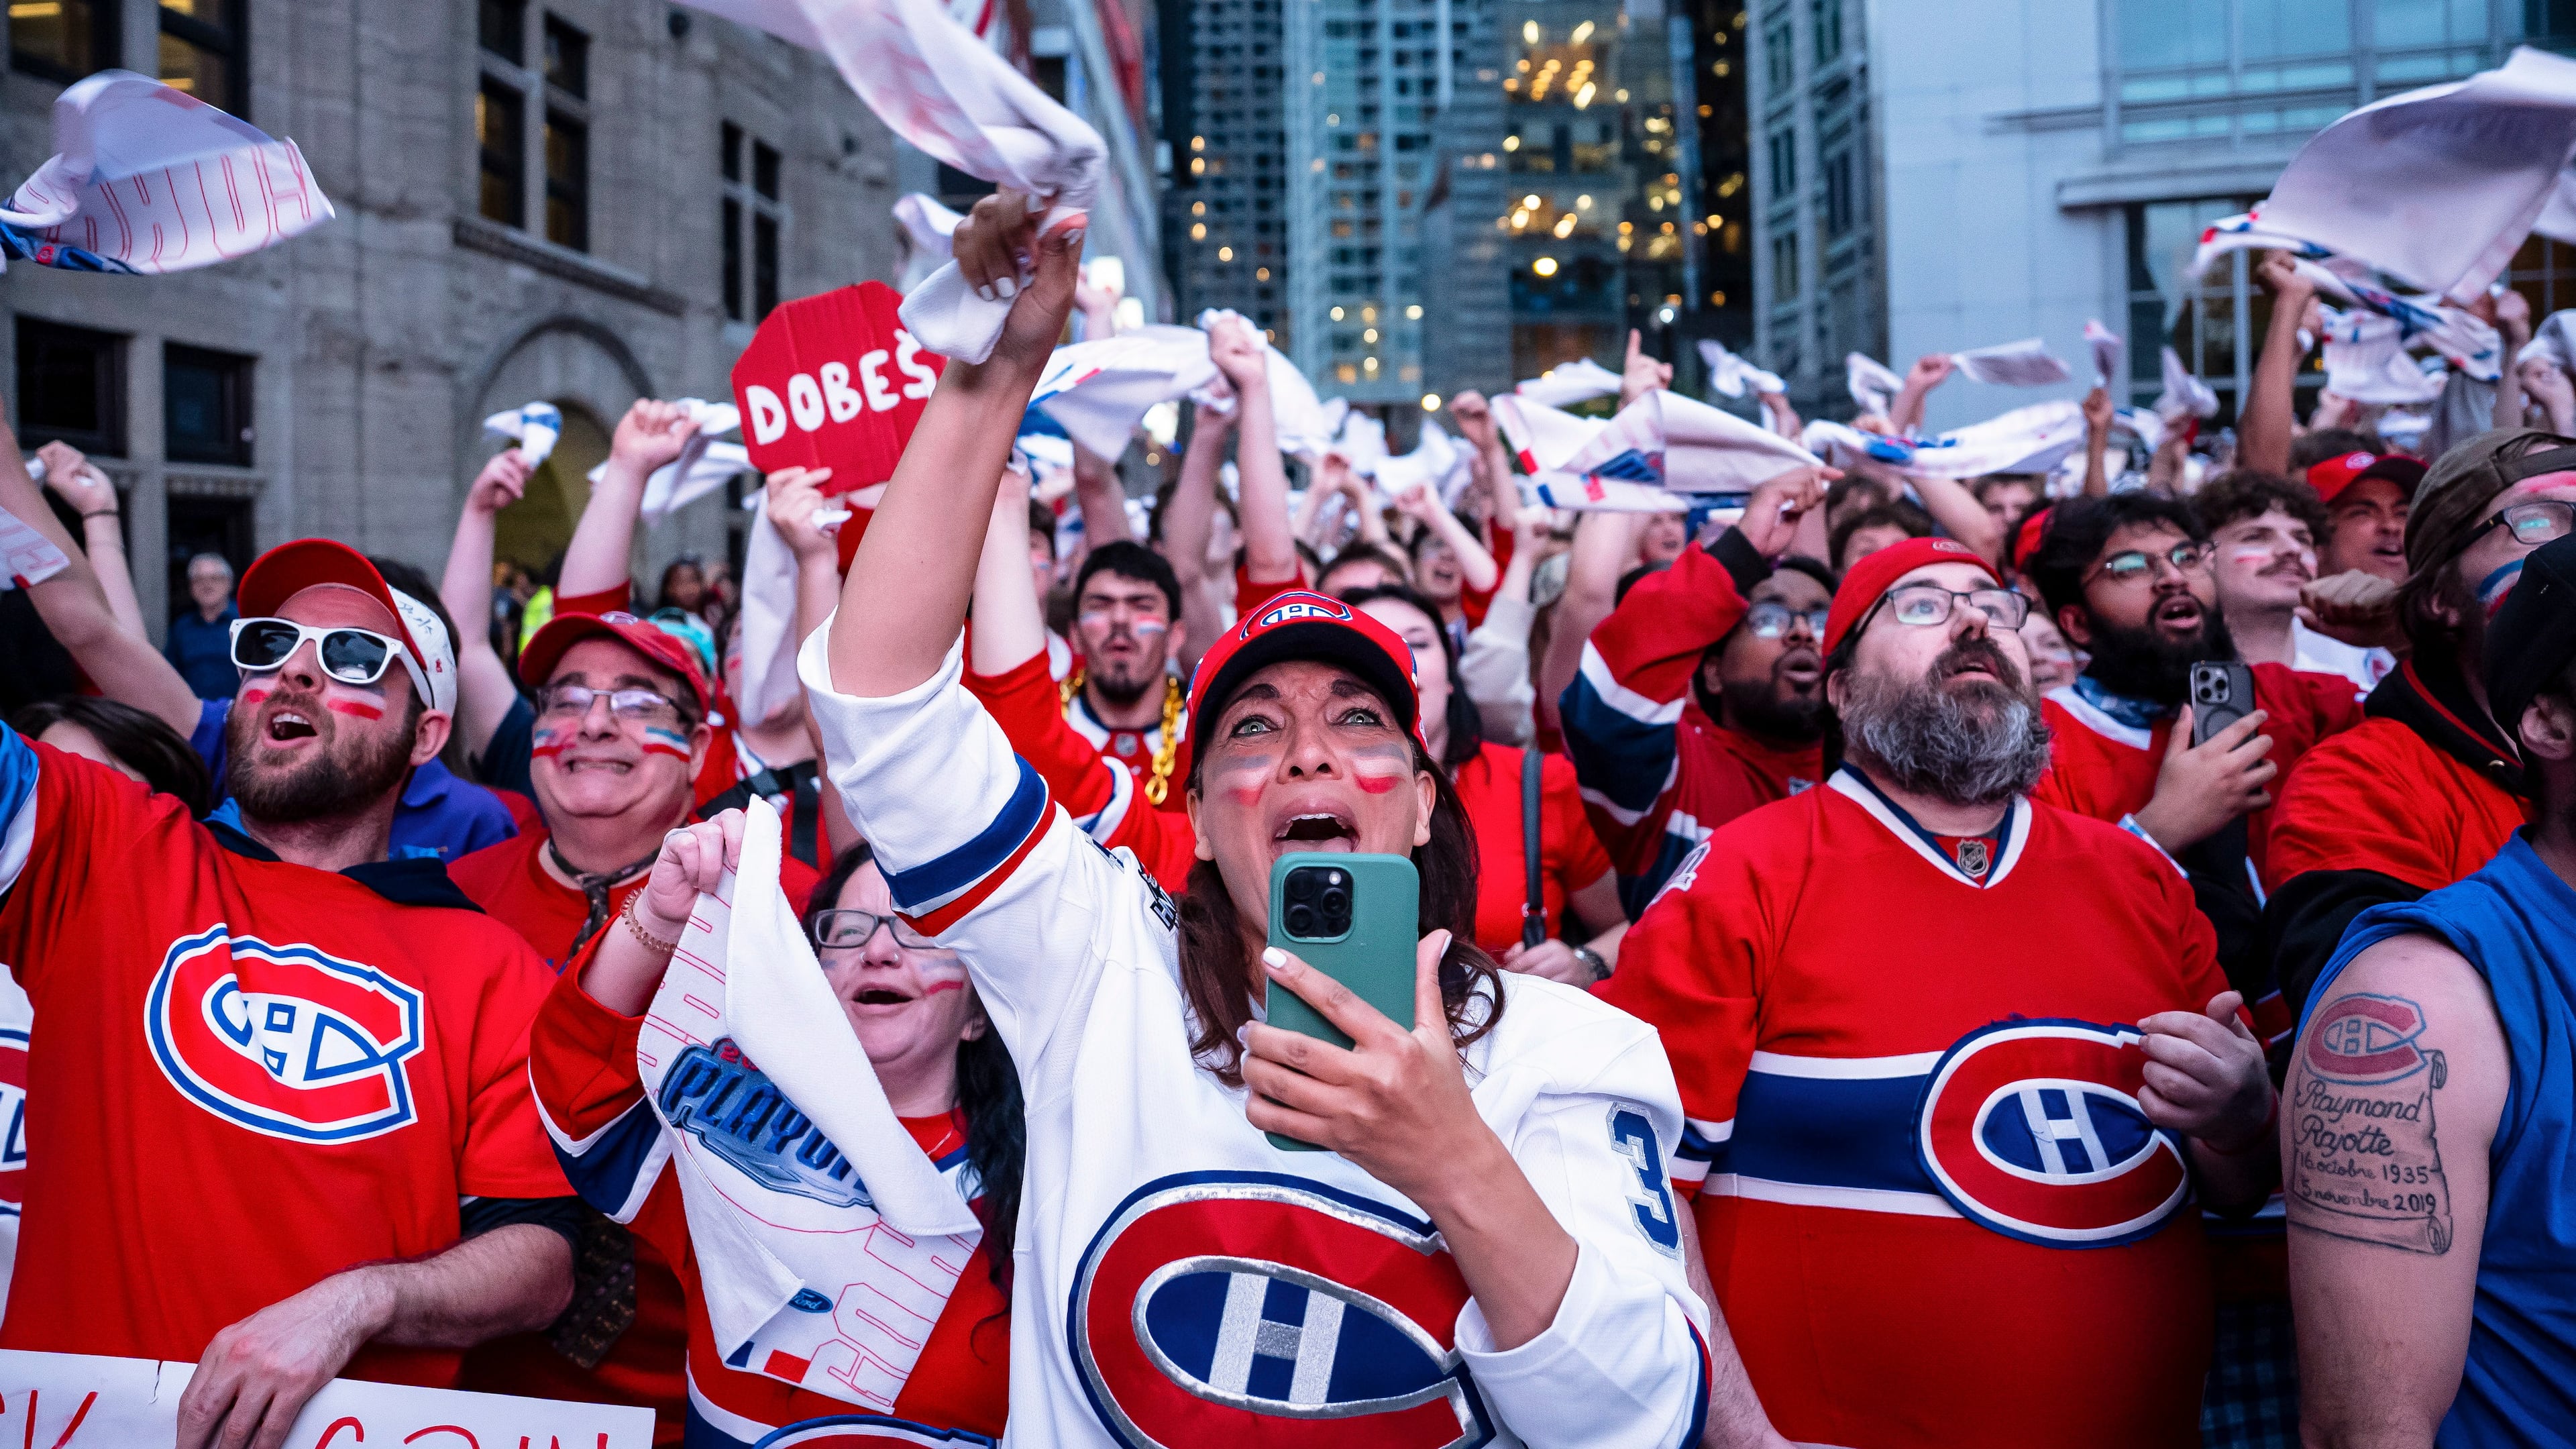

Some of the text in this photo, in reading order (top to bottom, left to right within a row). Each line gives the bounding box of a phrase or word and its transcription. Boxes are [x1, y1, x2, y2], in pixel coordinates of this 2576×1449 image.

[2296, 1079, 2424, 1123] Raymond
[661, 1056, 869, 1195] PLAYO
[2296, 1114, 2395, 1158] Rajotte
[2383, 1164, 2429, 1184] 1935
[2393, 1193, 2436, 1214] 2019
